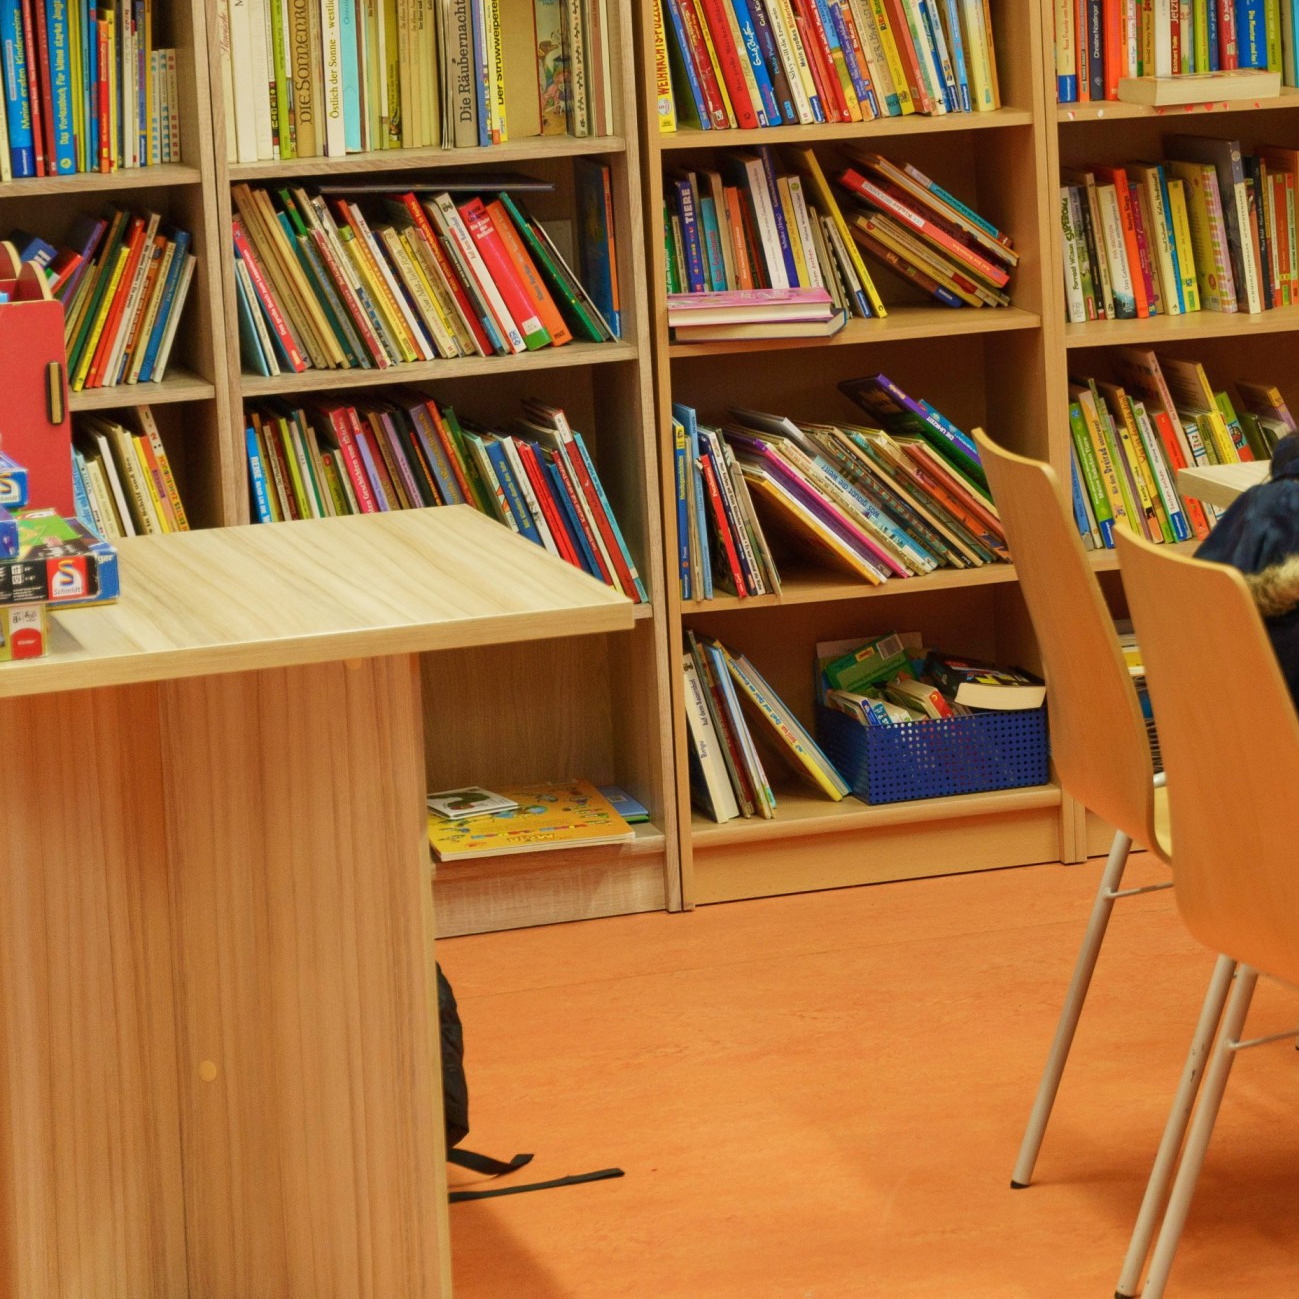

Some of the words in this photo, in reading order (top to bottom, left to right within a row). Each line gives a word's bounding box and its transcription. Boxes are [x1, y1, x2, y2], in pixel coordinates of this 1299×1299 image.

[327, 38, 338, 66] Sonne
[327, 68, 338, 83] der
[297, 94, 313, 124] DIE
[327, 86, 341, 119] Östlich
[458, 97, 472, 122] Die
[681, 187, 695, 224] TIERE
[53, 586, 81, 595] Schmidt
